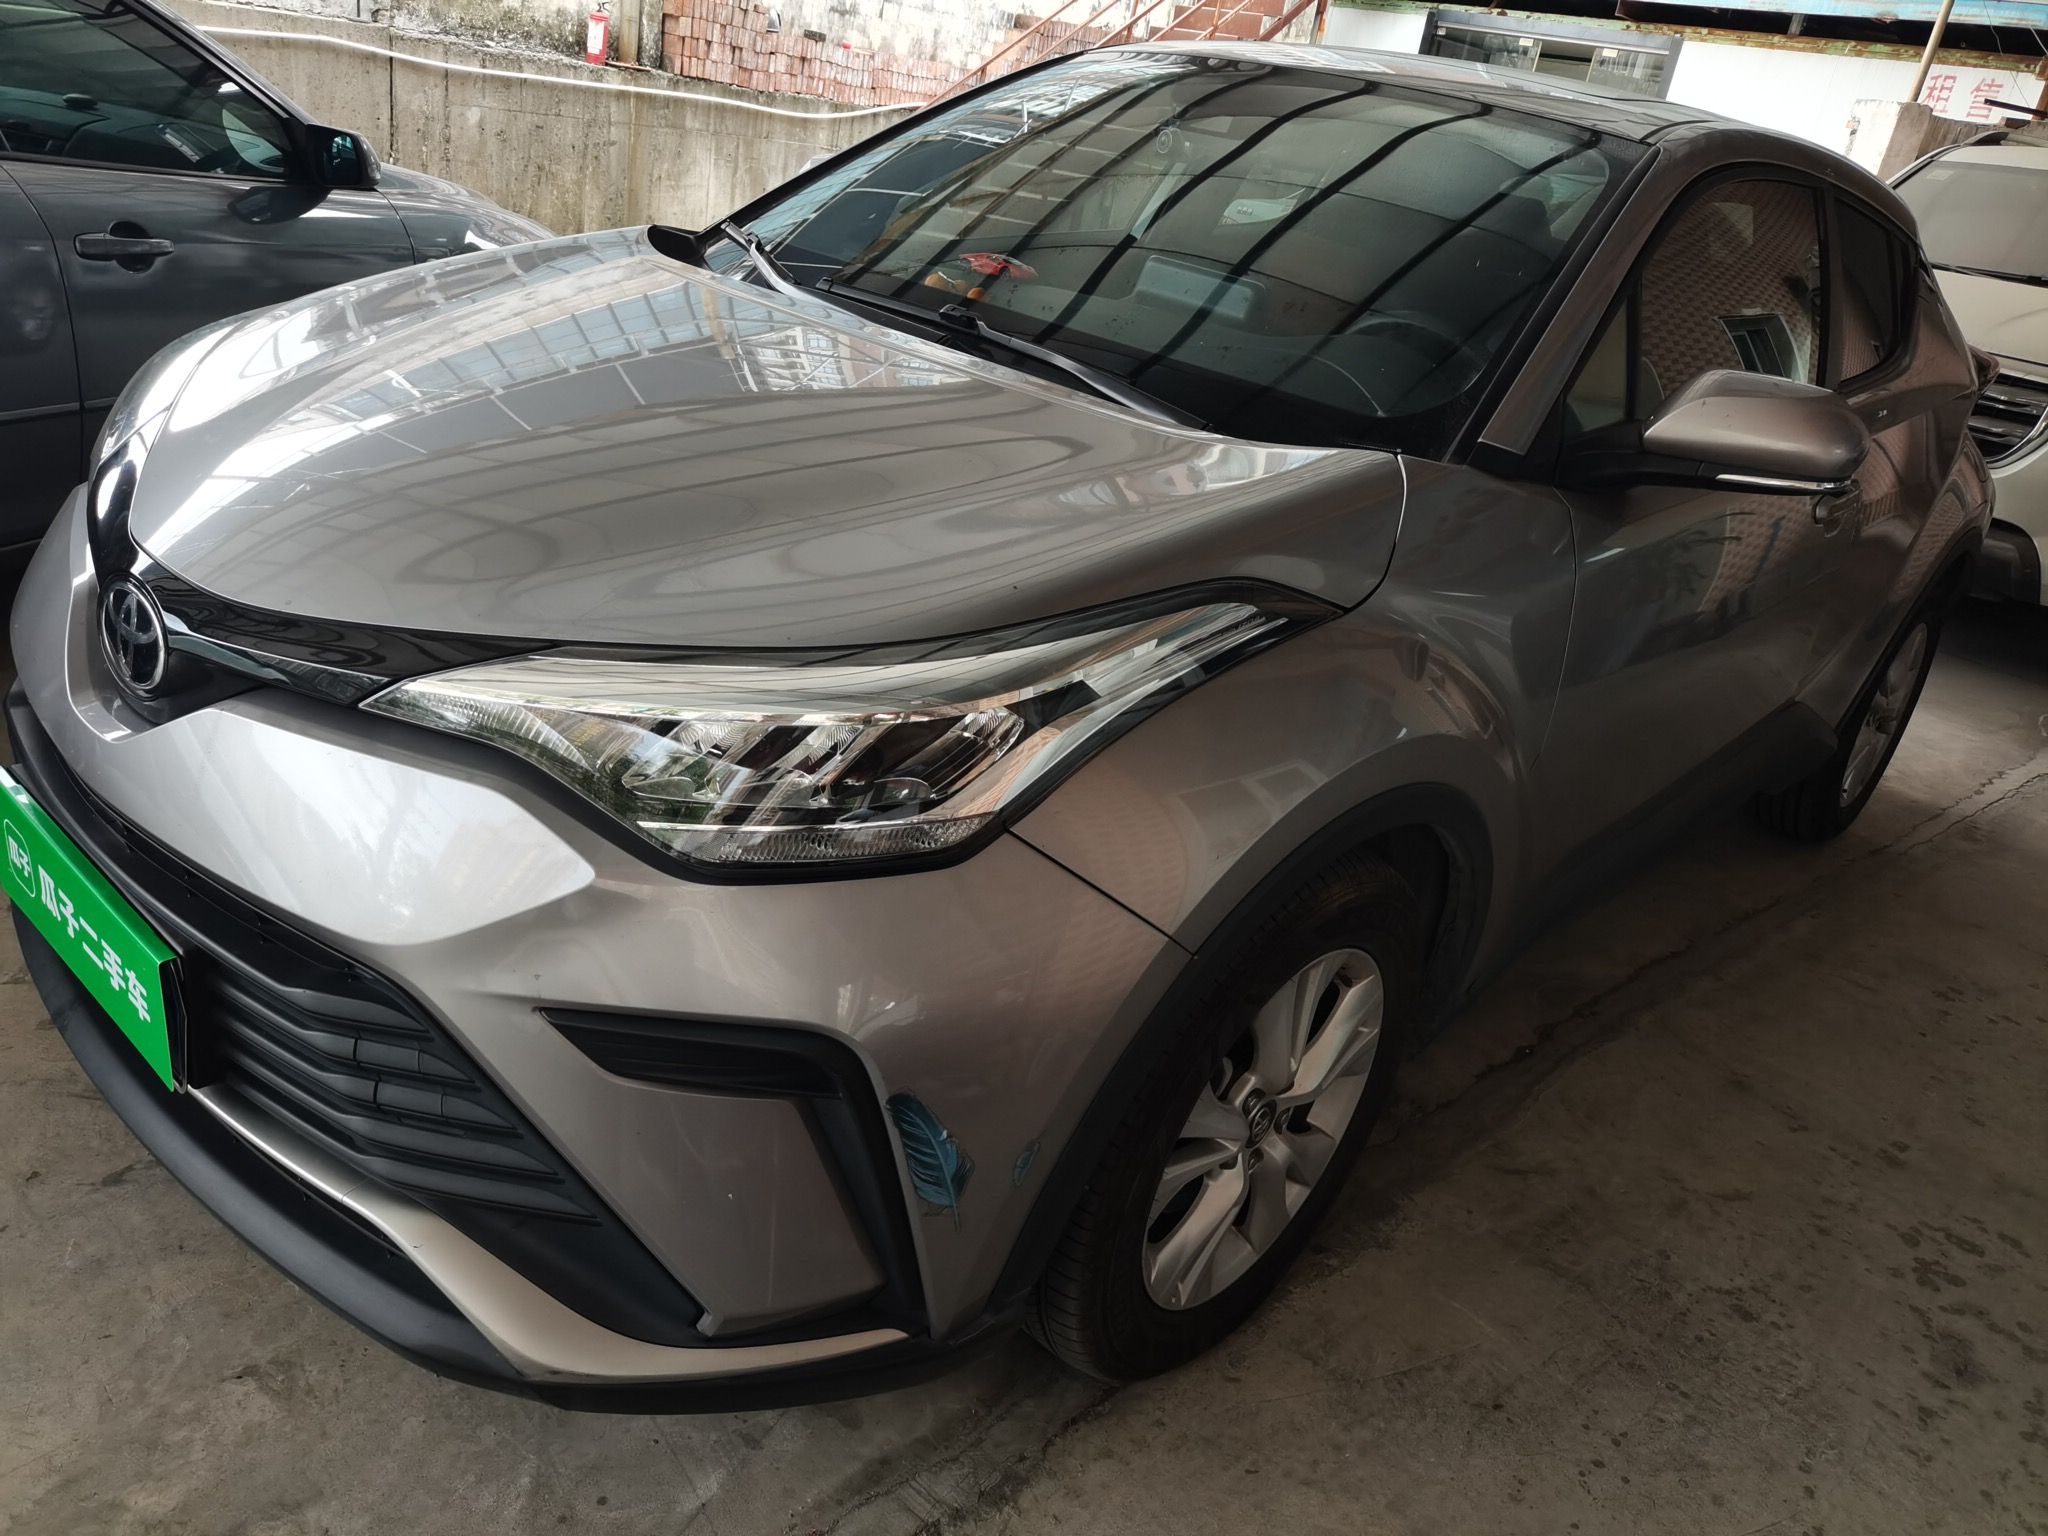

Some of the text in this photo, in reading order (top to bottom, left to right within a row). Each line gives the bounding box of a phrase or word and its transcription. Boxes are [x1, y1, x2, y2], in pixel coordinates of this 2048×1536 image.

[1924, 74, 2004, 119] 租售
[8, 834, 31, 878] 瓜子
[38, 864, 151, 1023] 瓜子二手车
